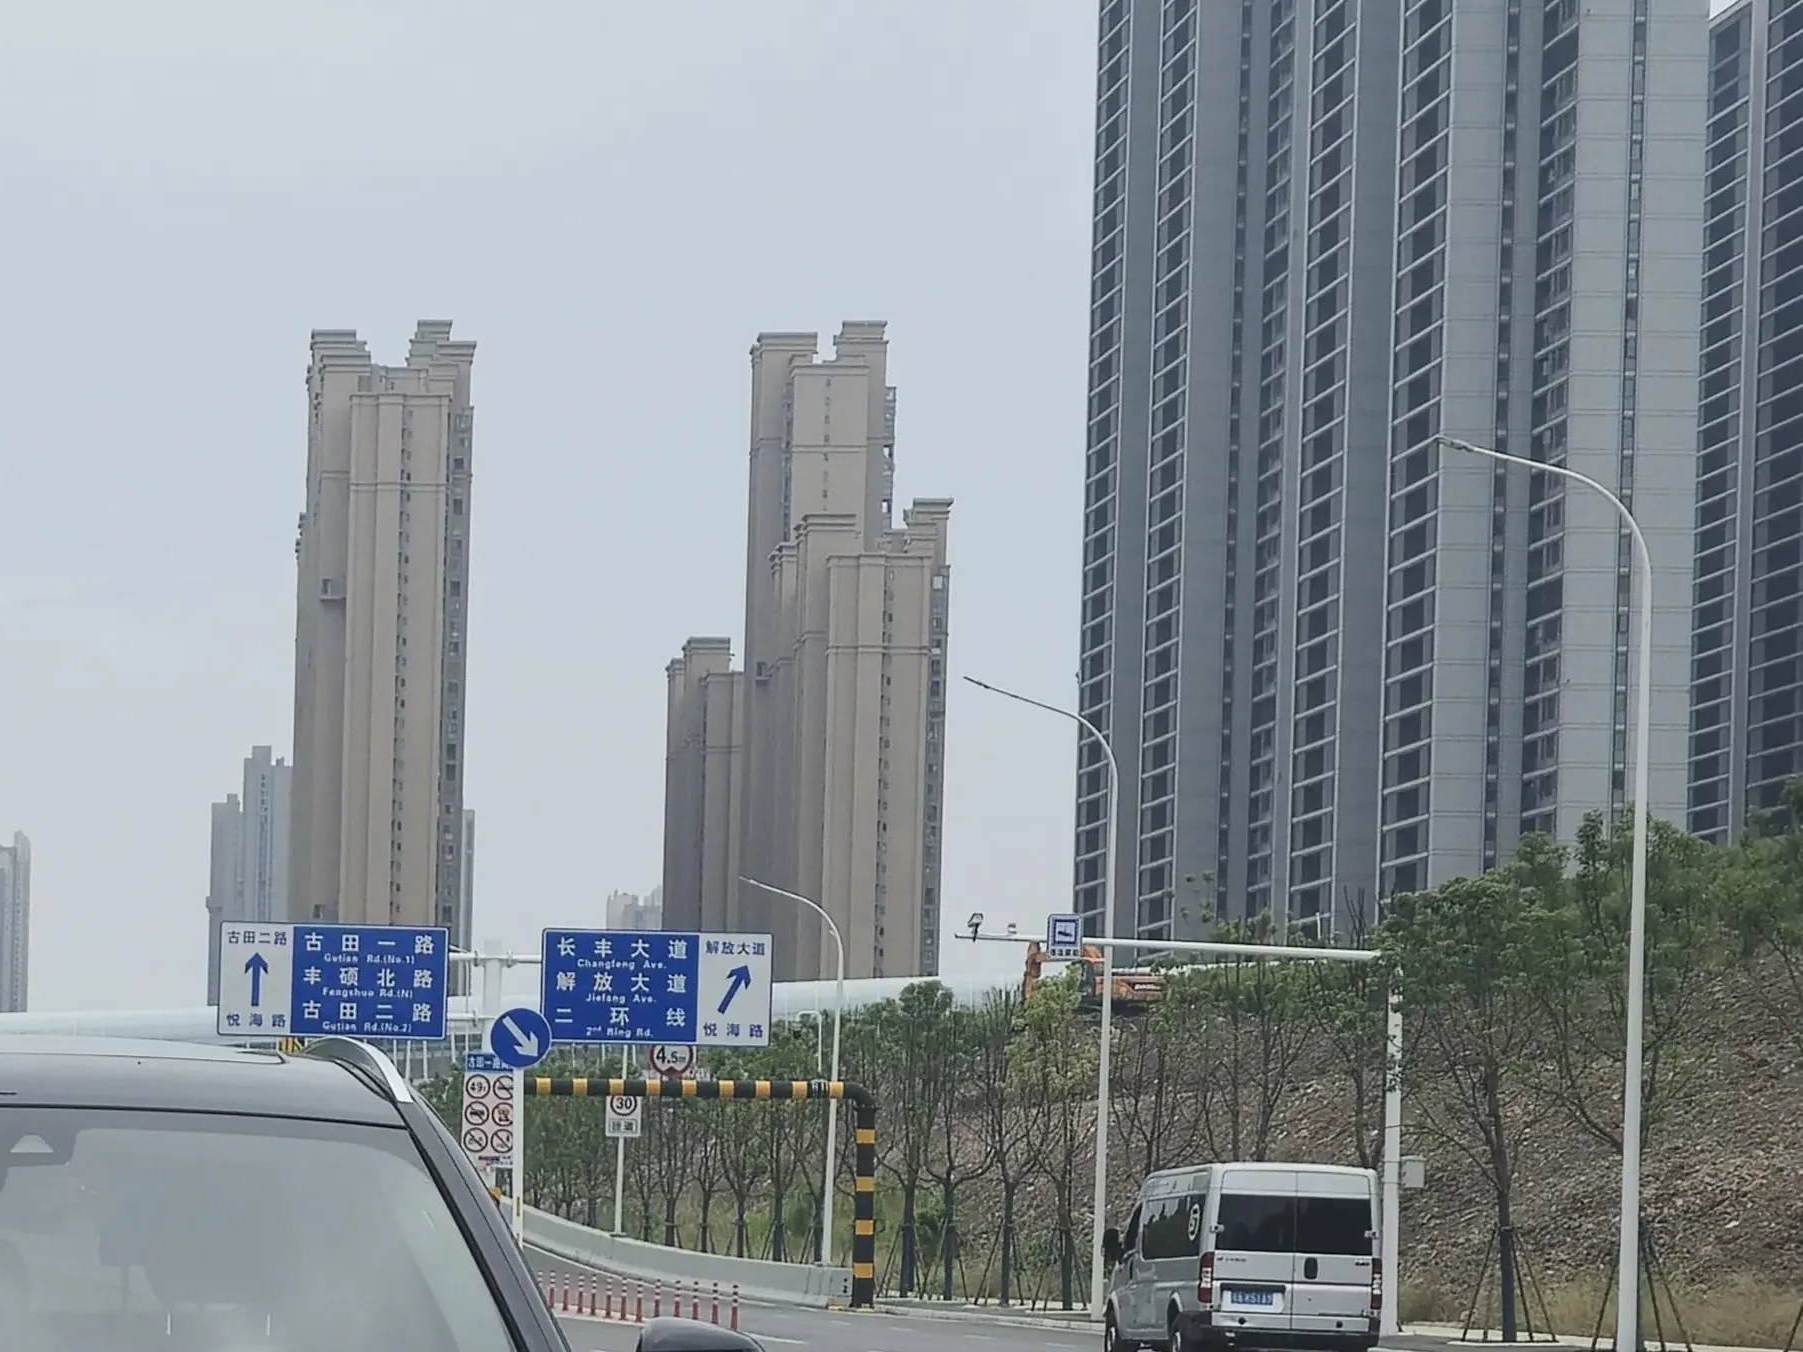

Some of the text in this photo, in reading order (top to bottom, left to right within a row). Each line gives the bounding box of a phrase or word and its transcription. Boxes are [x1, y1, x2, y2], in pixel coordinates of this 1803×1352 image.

[227, 931, 287, 946] 古田二路
[305, 932, 434, 954] 古田一路
[557, 937, 687, 959] 长丰大道
[705, 940, 766, 956] 解放大道
[324, 953, 358, 963] Gutian
[577, 958, 667, 969] Changfeng Ave.
[303, 966, 433, 989] 丰硕北路
[556, 972, 687, 994] 解放大道
[323, 987, 374, 998] Fengshuo
[585, 993, 657, 1004] Jiefang Ave.
[302, 1000, 432, 1023] 古田二路
[555, 1007, 686, 1027] 二环线
[226, 1012, 286, 1028] 悦海路
[322, 1021, 357, 1032] Gutian
[607, 1027, 632, 1039] Ring
[636, 1028, 654, 1038] Rd.
[703, 1022, 764, 1039] 悦海路
[616, 1097, 632, 1109] 30
